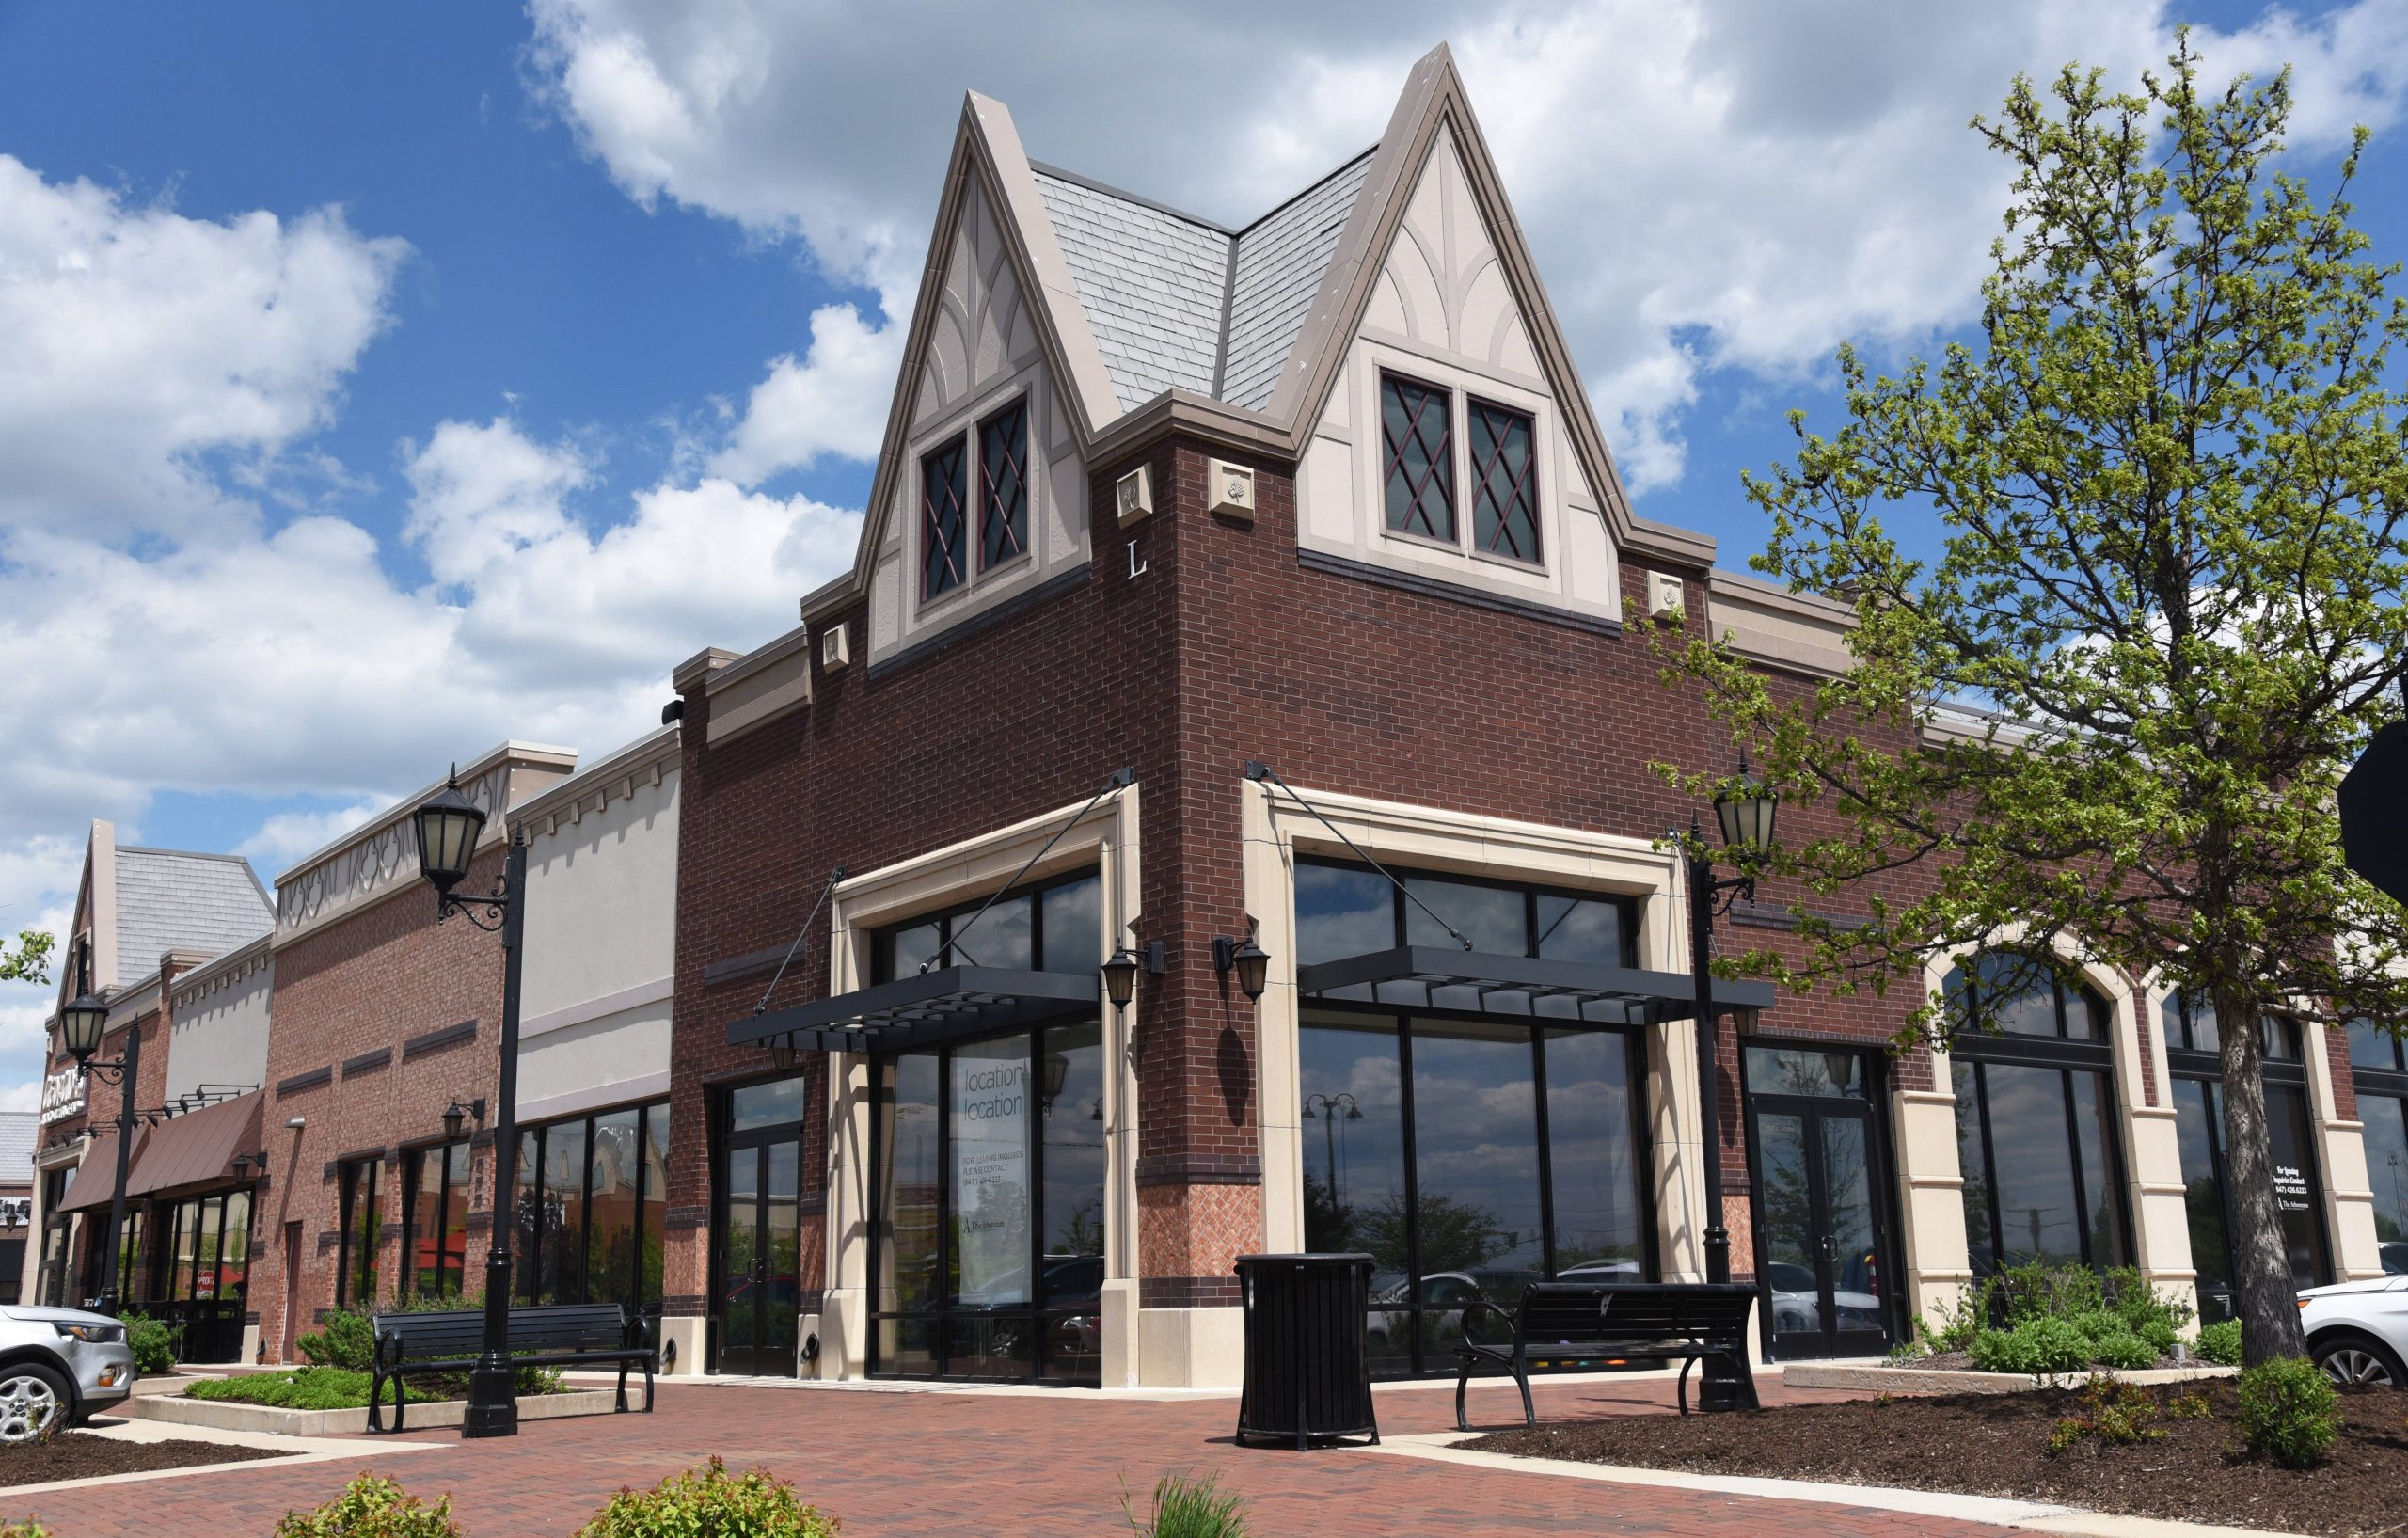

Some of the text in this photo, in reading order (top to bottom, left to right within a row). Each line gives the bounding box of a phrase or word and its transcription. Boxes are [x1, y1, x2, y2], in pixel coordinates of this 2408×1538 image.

[1127, 539, 1147, 579] L
[962, 1157, 974, 1165] FOR
[976, 1153, 997, 1165] LEASING
[962, 1164, 1008, 1176] PLEASE CONTACT
[2284, 1166, 2299, 1177] Leasing
[2275, 1185, 2286, 1194] 847)
